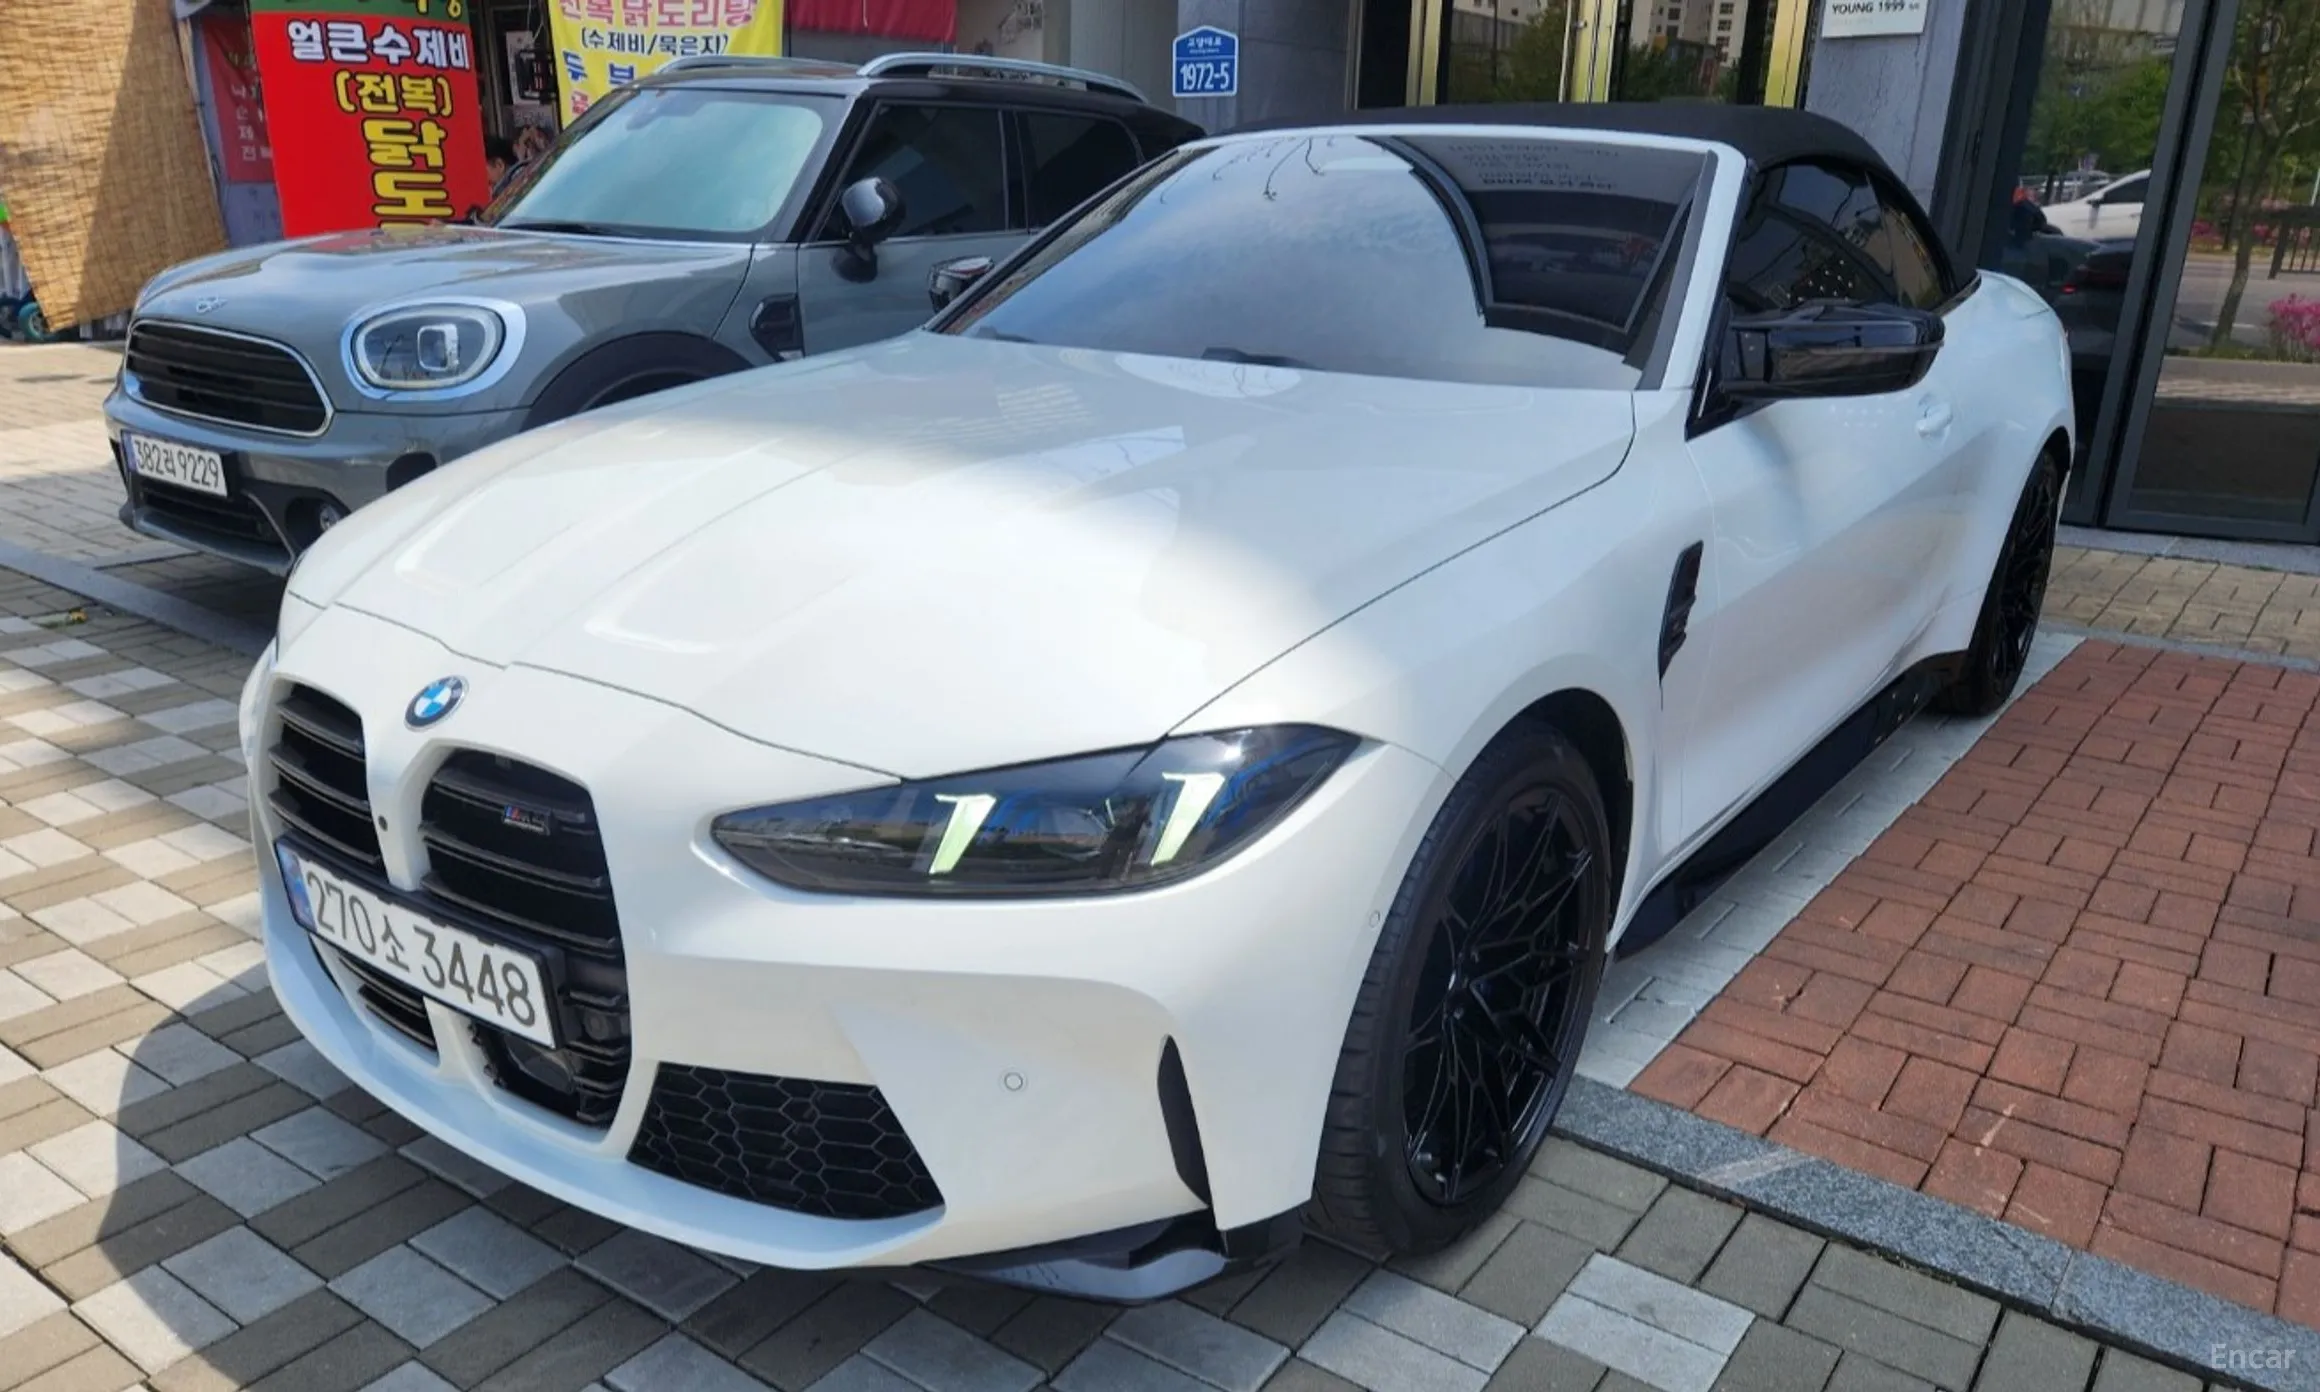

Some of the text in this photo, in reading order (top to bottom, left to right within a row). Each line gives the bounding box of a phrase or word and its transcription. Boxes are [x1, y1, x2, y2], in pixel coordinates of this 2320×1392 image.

[1832, 3, 1874, 14] YOUNG
[1879, 0, 1905, 12] 1999
[288, 21, 470, 69] 얼큰수제비
[581, 27, 729, 56] (수제비/묵은지)
[335, 71, 452, 116] (전복)
[1180, 62, 1231, 90] 1972-5
[177, 450, 219, 488] 9229
[307, 872, 536, 1027] 270소 3448
